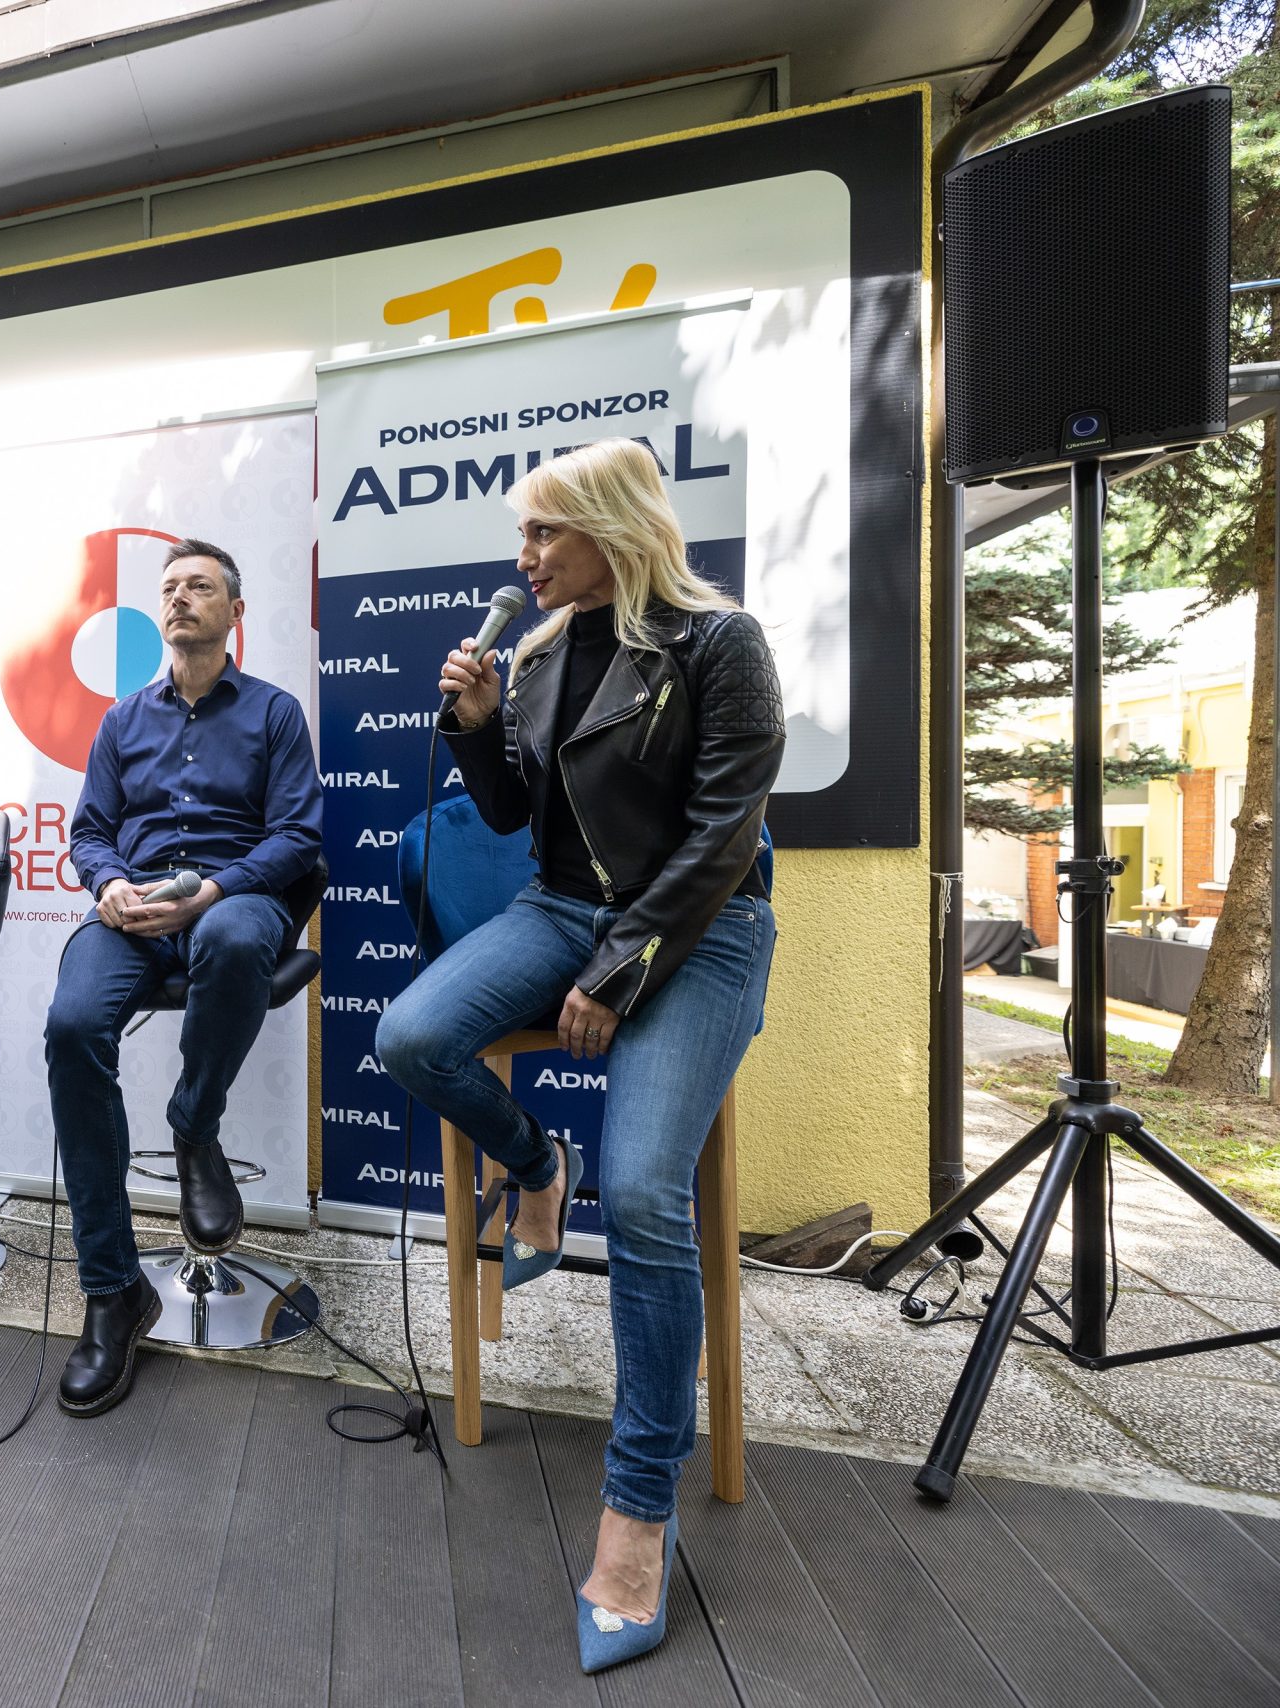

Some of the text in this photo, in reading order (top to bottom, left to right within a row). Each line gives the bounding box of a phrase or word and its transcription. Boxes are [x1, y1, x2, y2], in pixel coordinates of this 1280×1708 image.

[379, 389, 670, 448] PONOSNI SPONZOR
[332, 424, 730, 522] ADML
[354, 588, 491, 618] ADMIRAL
[4, 909, 84, 923] ww.crorec.hr
